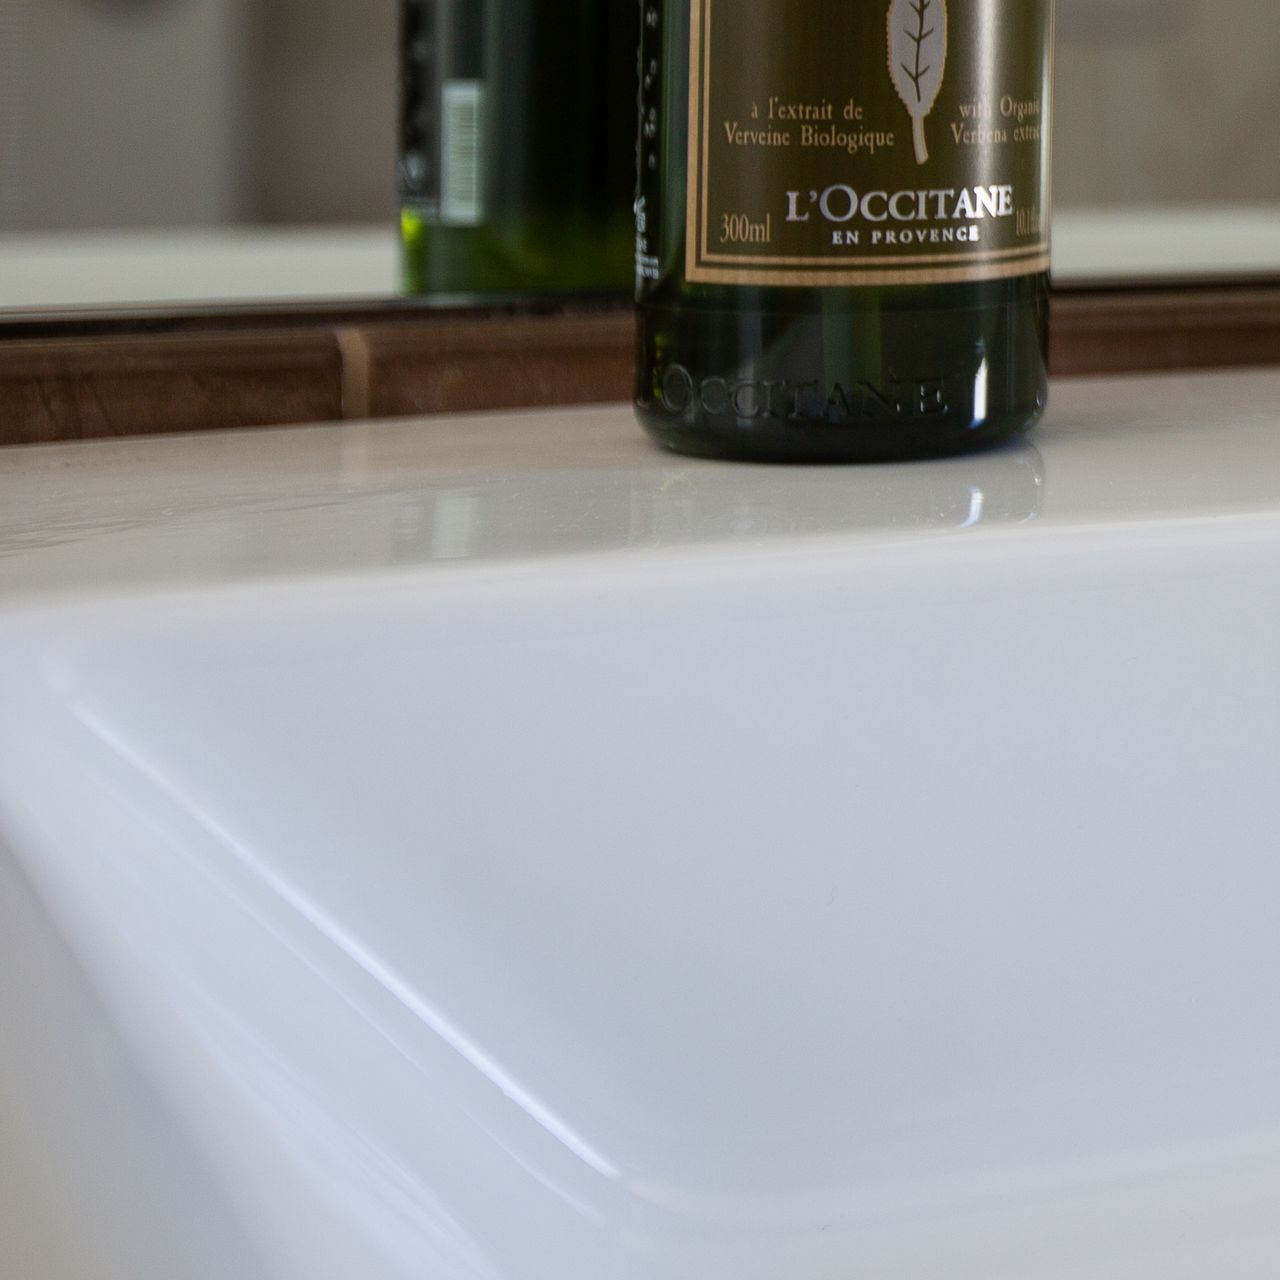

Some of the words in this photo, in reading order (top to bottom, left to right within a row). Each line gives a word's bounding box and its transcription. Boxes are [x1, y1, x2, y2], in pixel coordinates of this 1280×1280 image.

[768, 95, 833, 120] l'extrait
[843, 97, 864, 120] de
[724, 121, 791, 147] Verveine
[801, 123, 895, 155] Biologique
[951, 121, 1007, 146] Verbena
[786, 184, 1013, 222] L'OCCITANE
[719, 213, 770, 245] 300ml
[832, 229, 860, 246] EN
[872, 224, 980, 246] PROVENCE
